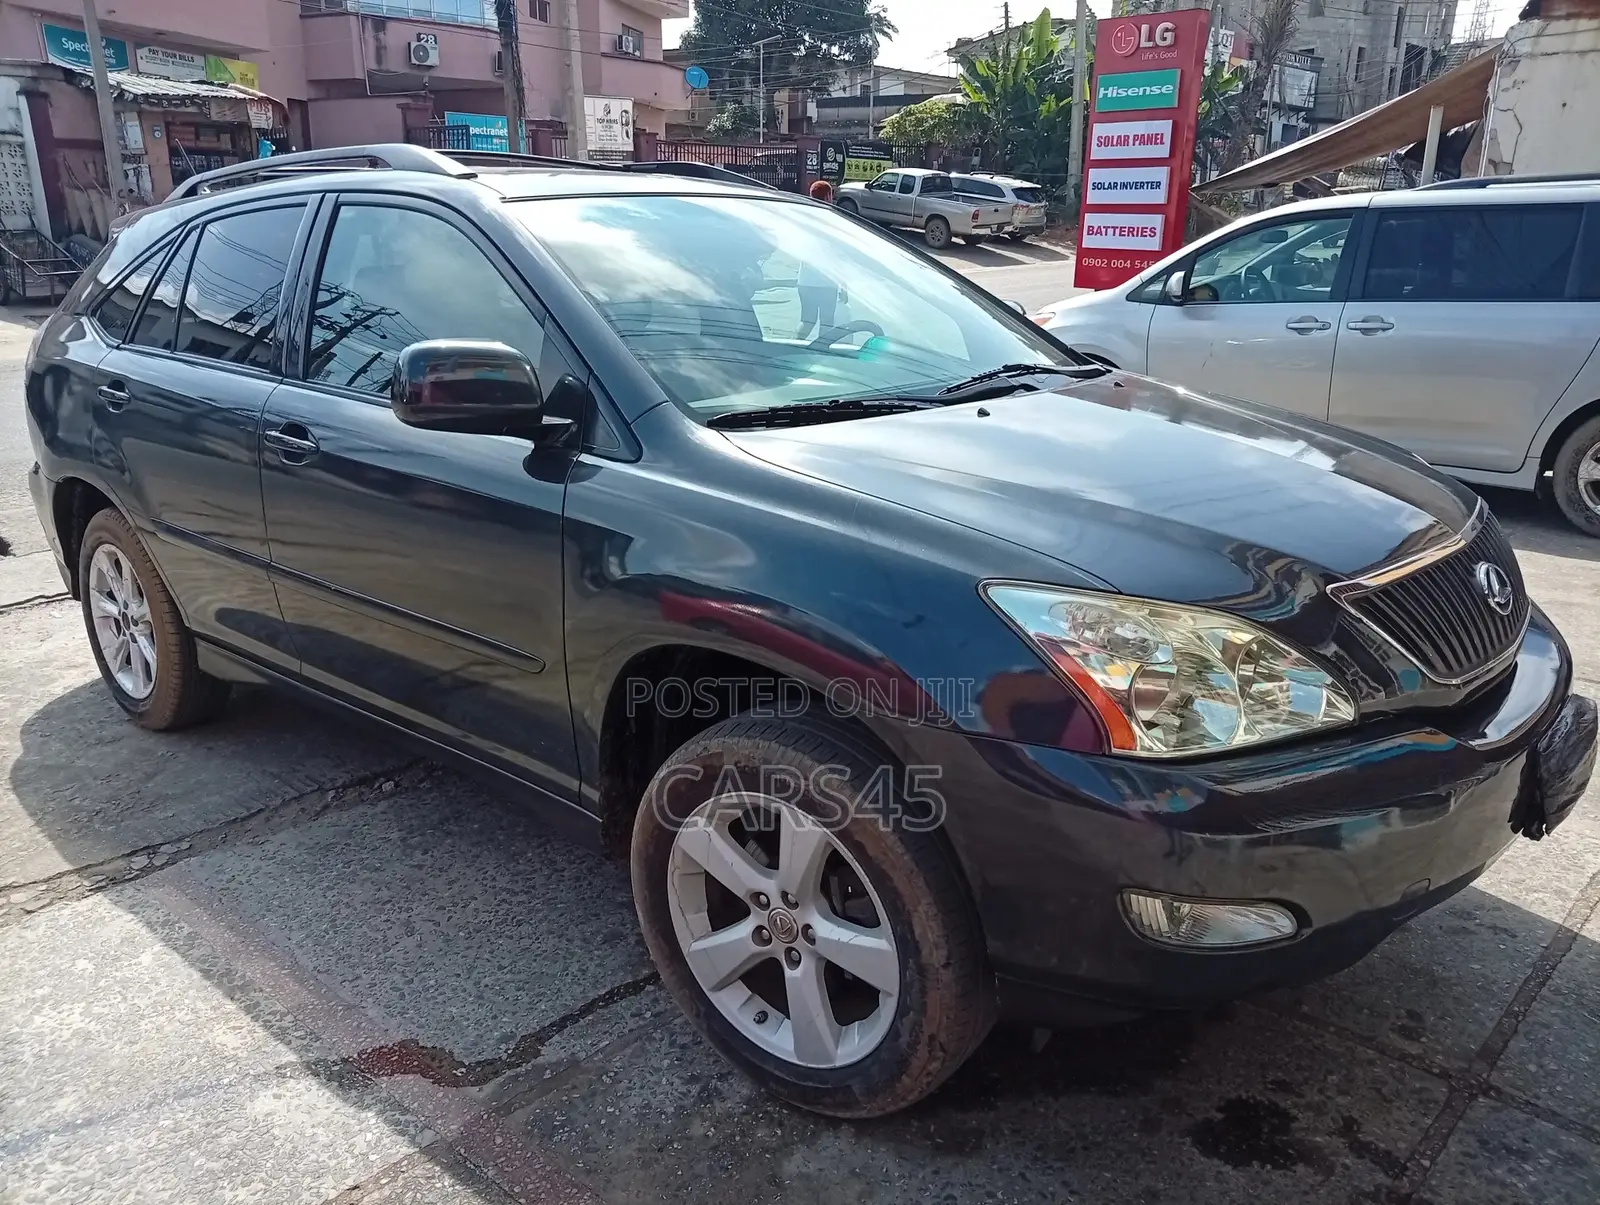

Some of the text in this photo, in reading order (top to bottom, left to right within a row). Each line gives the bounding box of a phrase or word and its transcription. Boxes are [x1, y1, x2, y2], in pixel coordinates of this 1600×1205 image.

[1140, 22, 1176, 48] LG
[148, 48, 195, 62] PAY YOUR BILLS
[1142, 50, 1178, 60] Life's Good
[1099, 84, 1174, 98] Hisense
[1096, 133, 1165, 148] SOLAR PANEL
[807, 153, 818, 166] 28
[1091, 181, 1162, 191] SOLAR INVERTER
[1086, 225, 1157, 238] BATTERIES
[1082, 257, 1108, 268] 0902
[1110, 259, 1131, 269] 004
